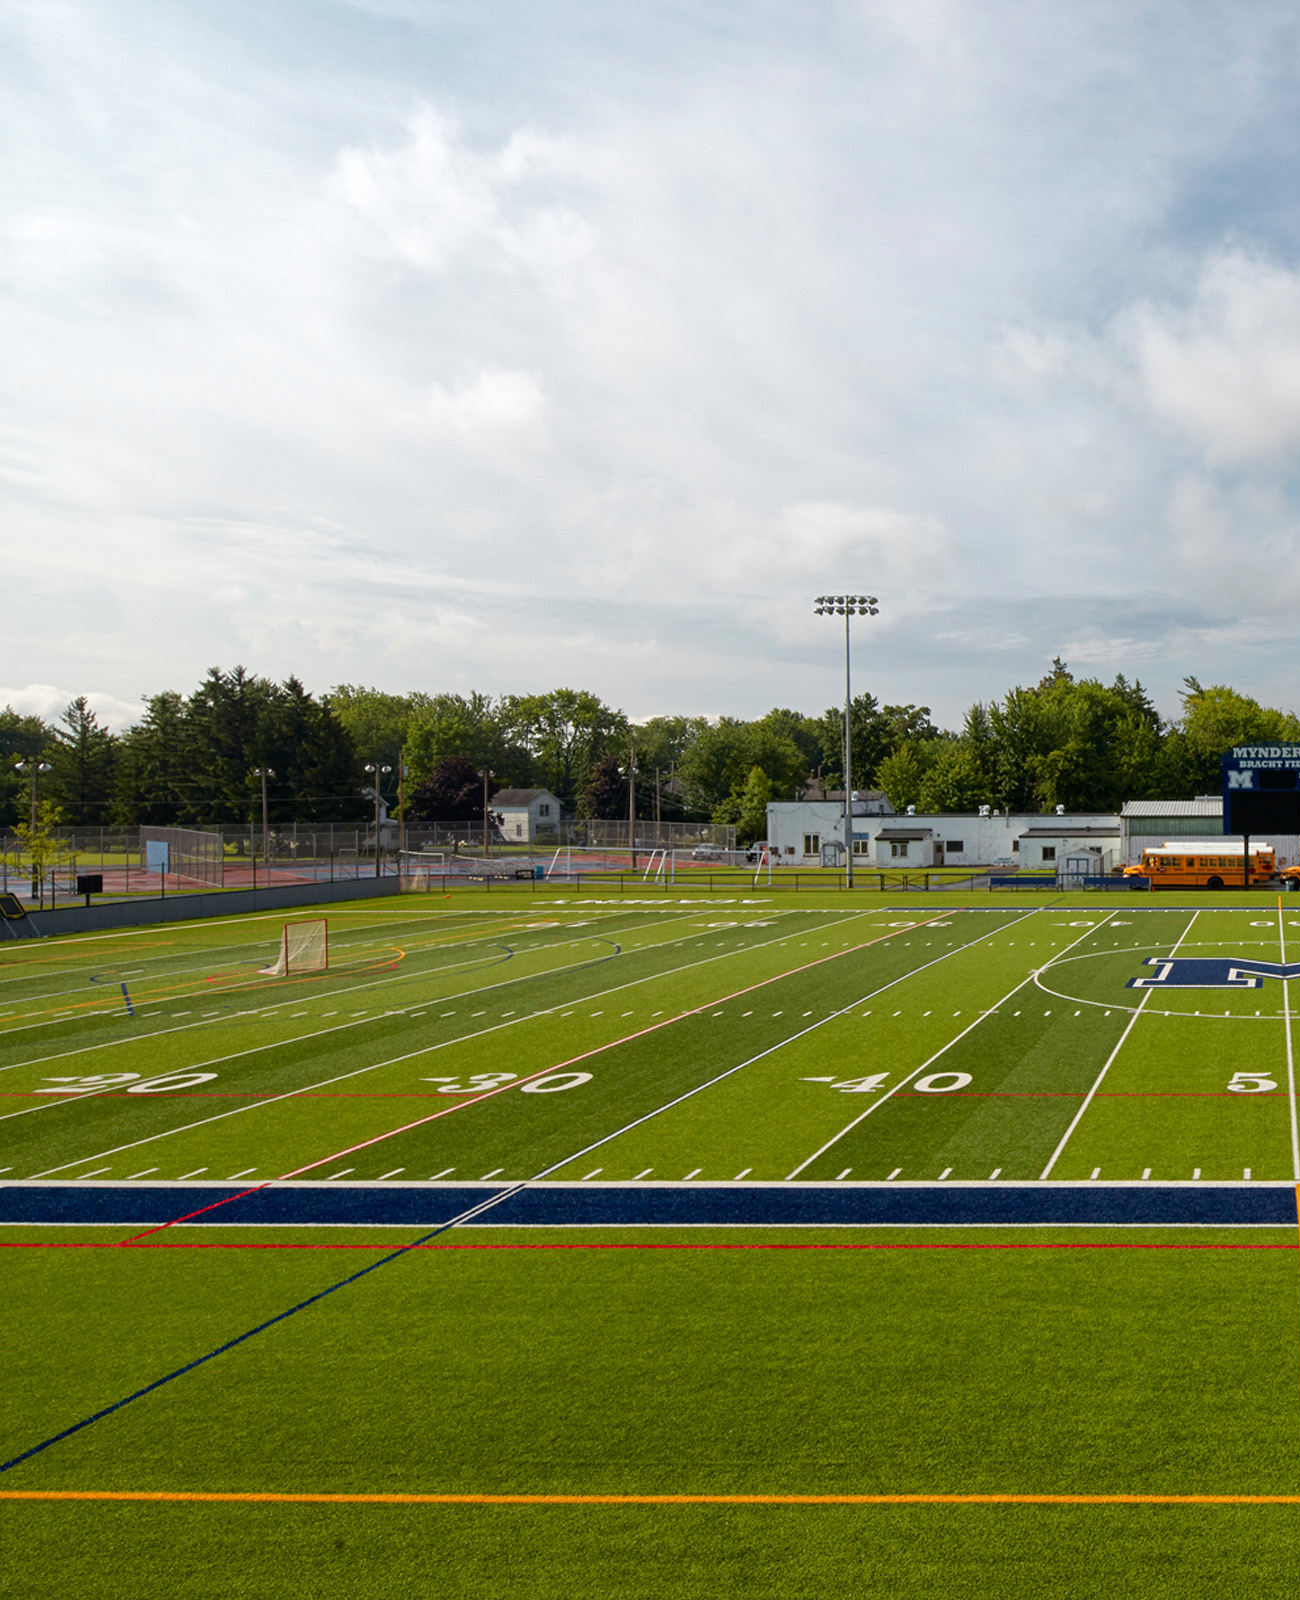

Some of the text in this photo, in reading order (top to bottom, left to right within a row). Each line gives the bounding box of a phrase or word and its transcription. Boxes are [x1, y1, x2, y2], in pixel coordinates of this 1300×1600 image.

[1239, 760, 1283, 768] BRACHT
[1228, 770, 1253, 789] M
[33, 1072, 218, 1094] 20
[436, 1072, 594, 1094] 30
[832, 1072, 973, 1093] 40
